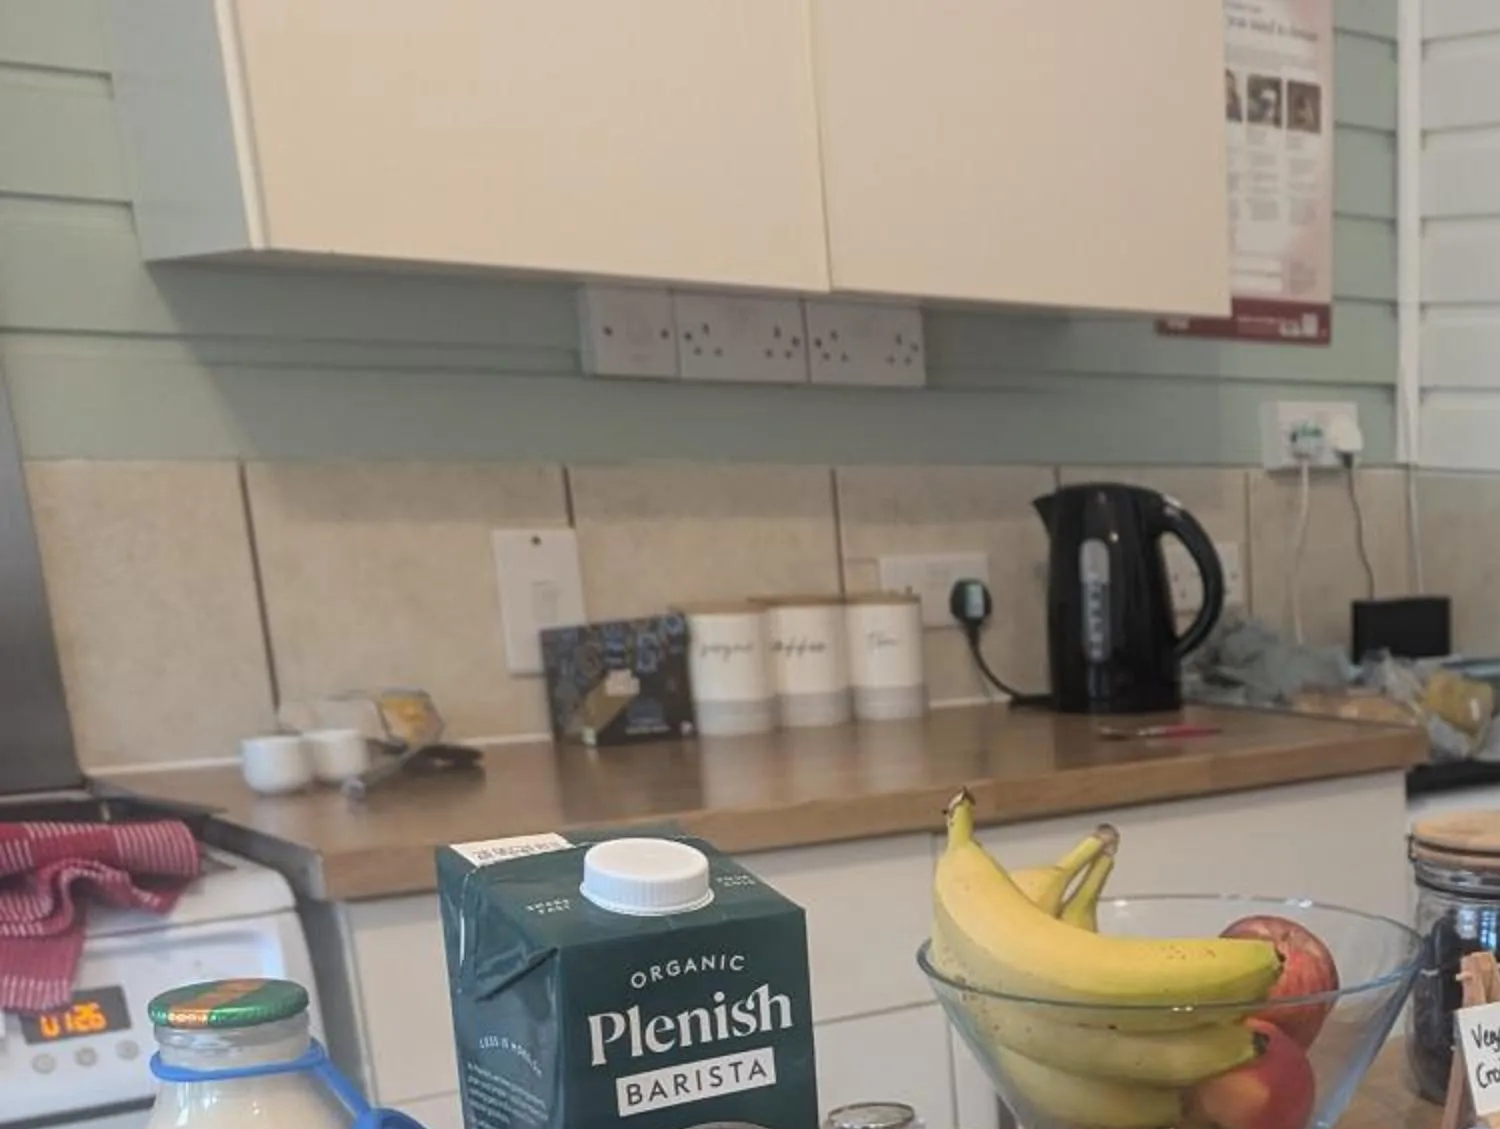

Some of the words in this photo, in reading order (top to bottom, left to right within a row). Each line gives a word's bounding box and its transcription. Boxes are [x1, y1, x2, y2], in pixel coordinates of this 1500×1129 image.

[629, 954, 746, 989] ORGANIC
[587, 983, 793, 1067] Plenish
[626, 1059, 767, 1106] BARISTA
